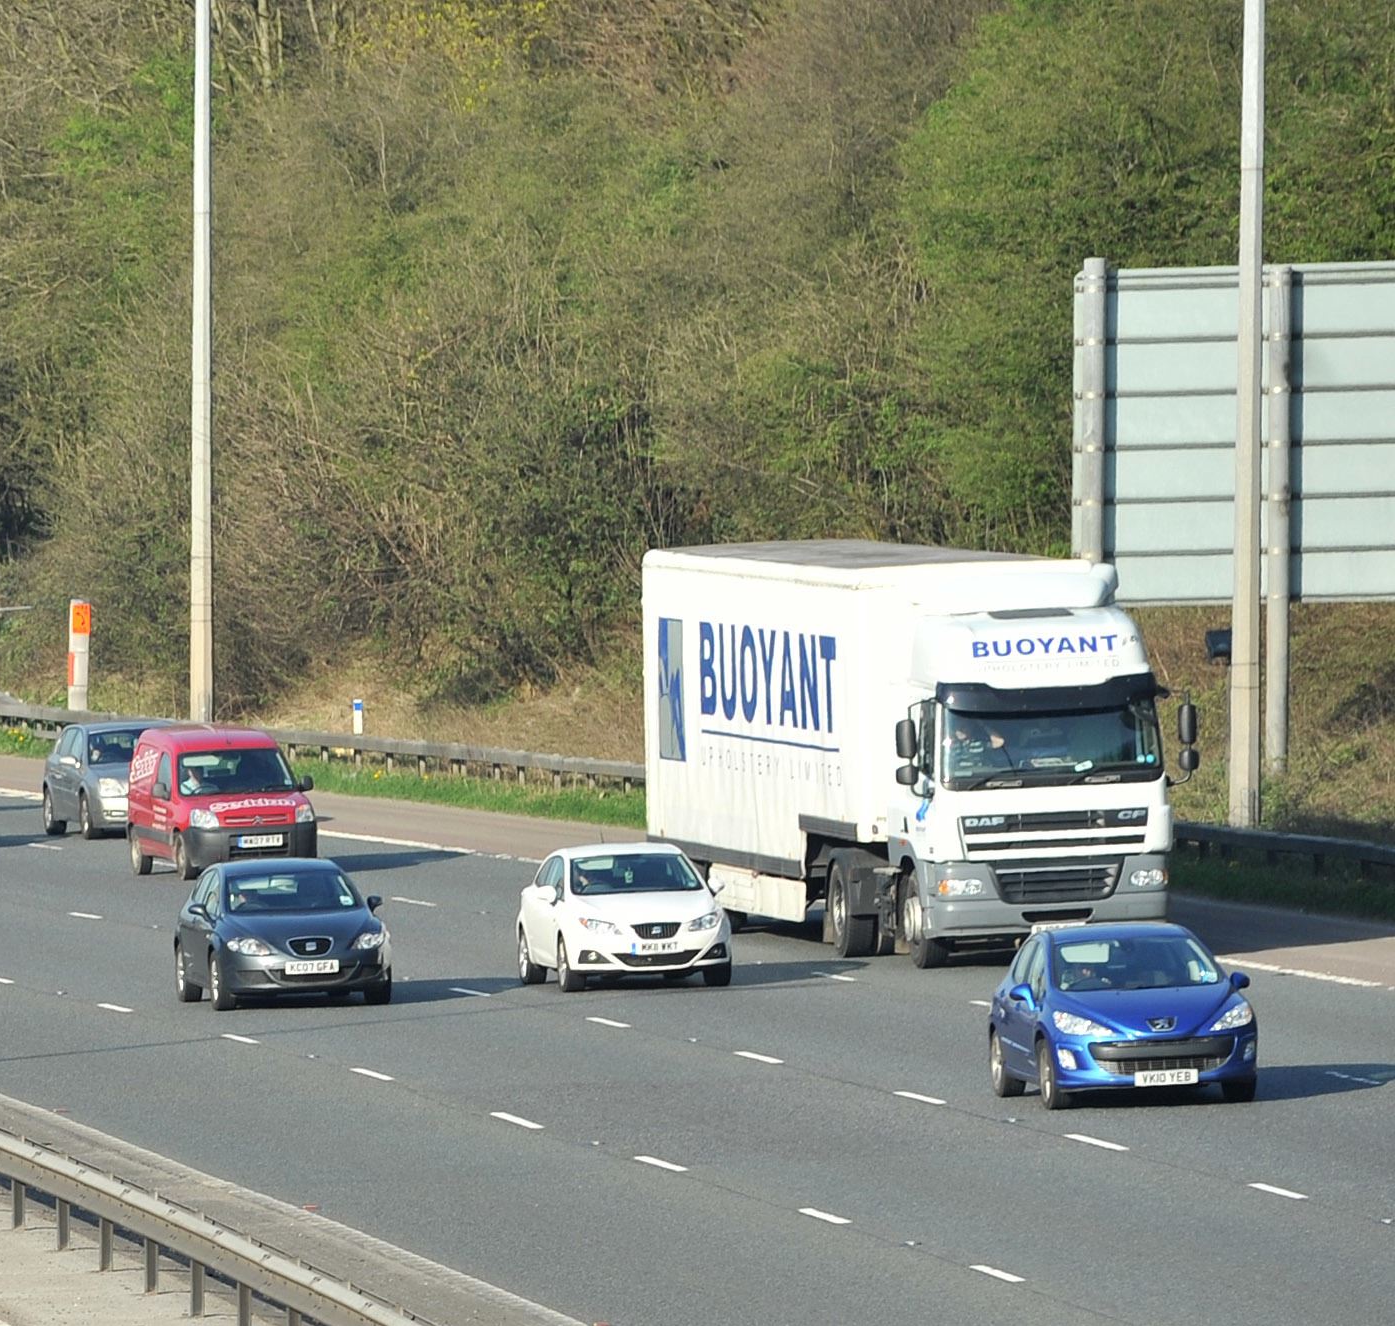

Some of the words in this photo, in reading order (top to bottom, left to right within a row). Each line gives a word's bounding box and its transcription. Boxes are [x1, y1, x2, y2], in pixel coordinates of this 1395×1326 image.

[971, 634, 1118, 659] BUOYANT
[699, 621, 837, 734] BUOYANT
[1117, 810, 1148, 821] CF
[964, 816, 1006, 828] DAF
[290, 962, 314, 972] KC07
[316, 961, 335, 971] GFA
[1141, 1073, 1166, 1083] VK10
[1169, 1071, 1191, 1082] YEB
